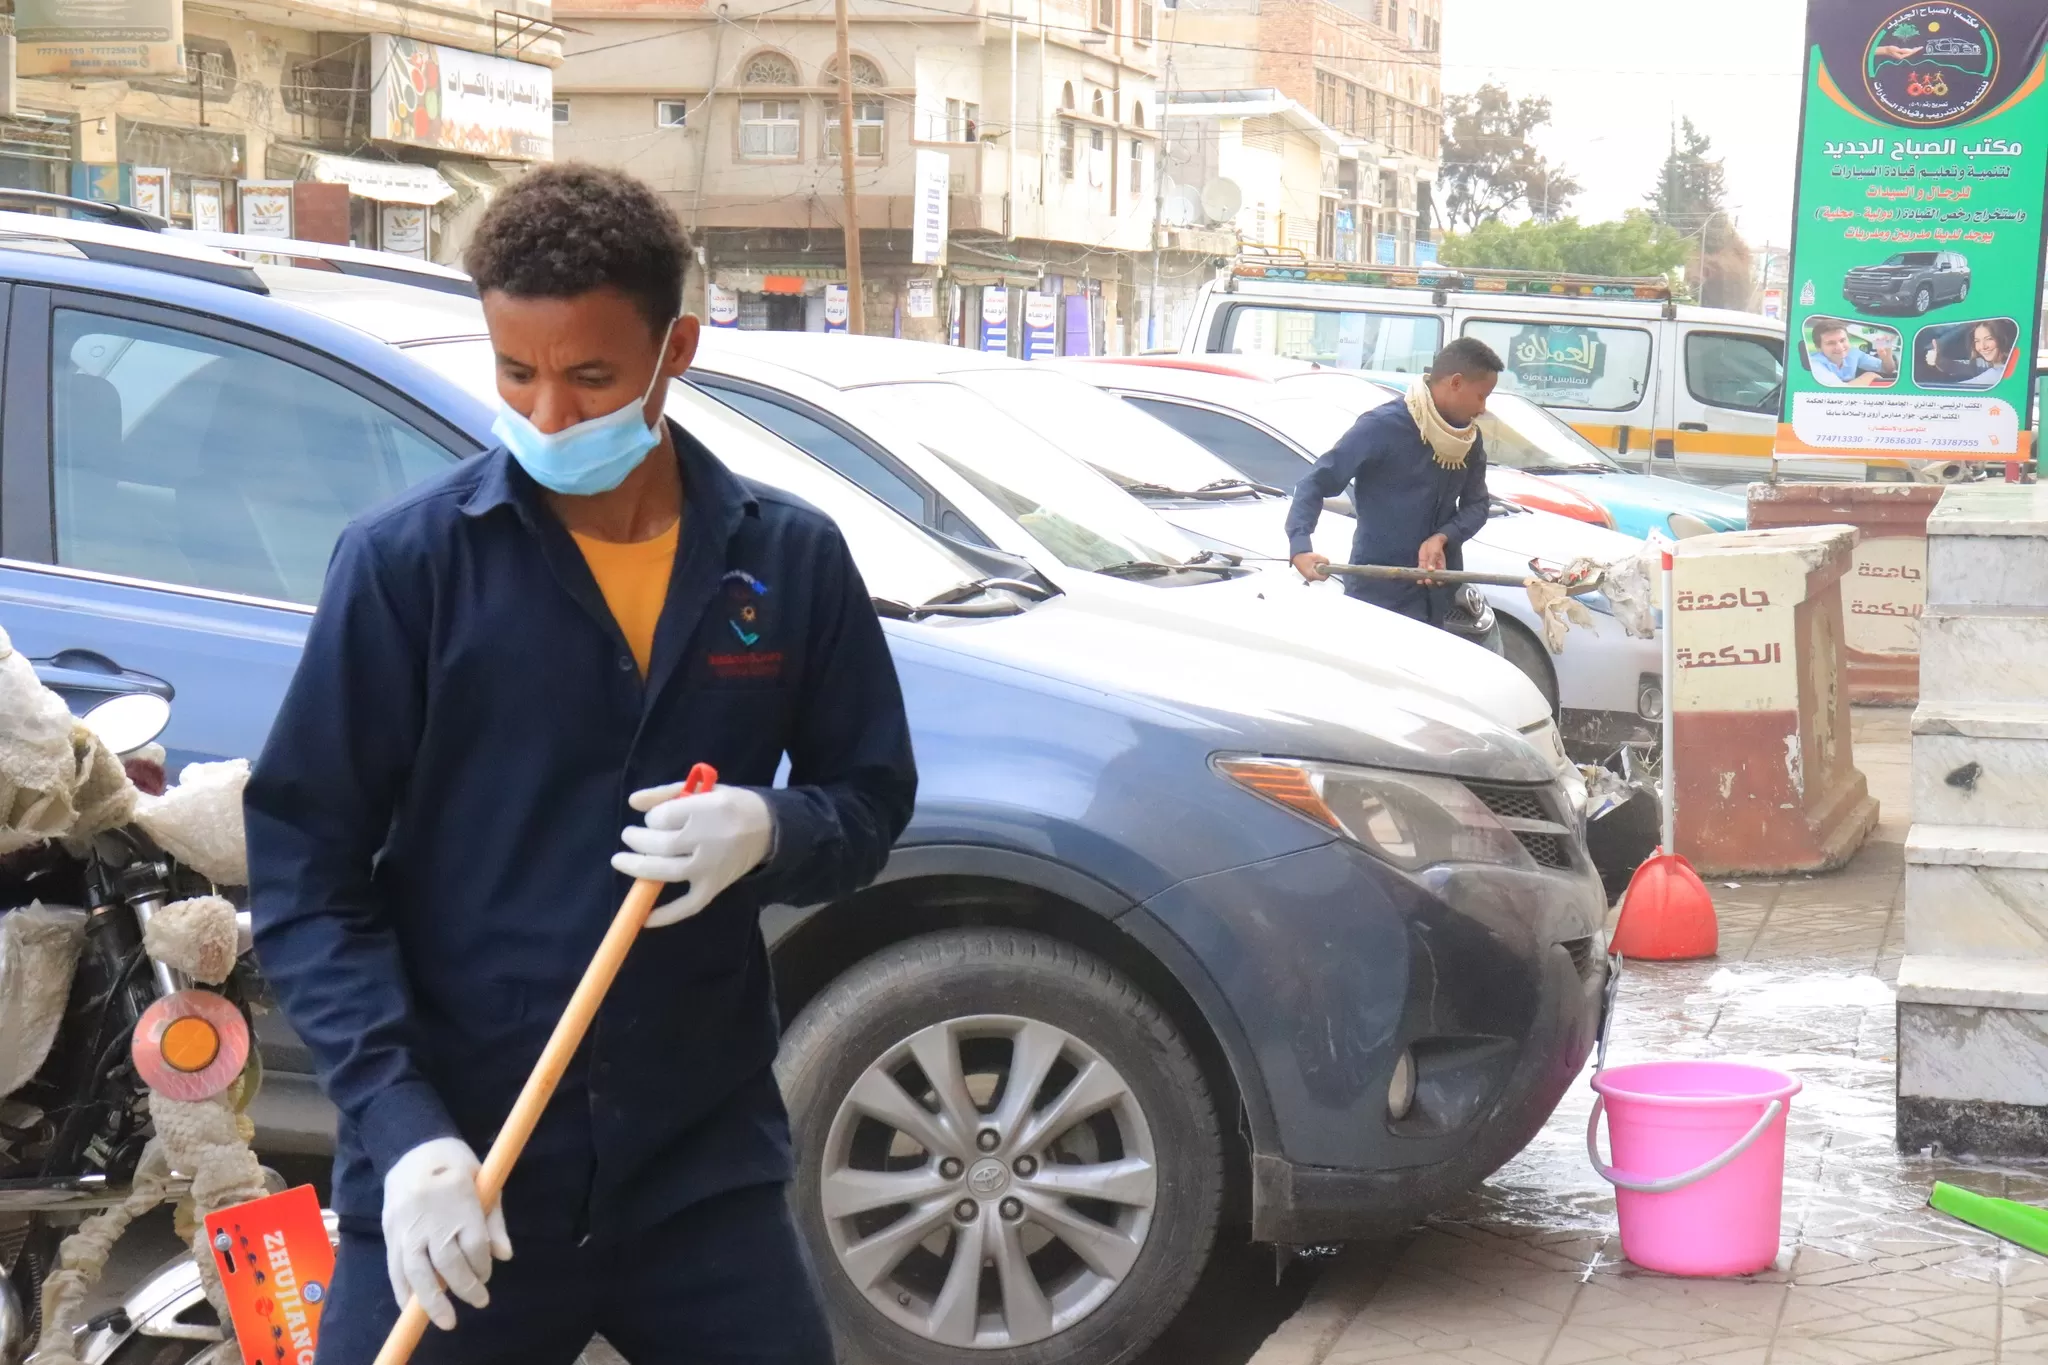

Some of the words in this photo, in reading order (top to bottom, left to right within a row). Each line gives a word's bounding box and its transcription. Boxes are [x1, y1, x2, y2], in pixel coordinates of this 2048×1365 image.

[1887, 8, 1919, 30] الجديد
[1920, 6, 1952, 17] الصباح
[1953, 9, 1979, 28] مكتب
[1873, 81, 1898, 109] السيارات
[1898, 105, 1924, 119] وقيادة
[1926, 105, 1965, 119] والتدريب
[1823, 138, 1884, 159] الجديد
[1890, 138, 1956, 161] الصباح
[1963, 138, 2022, 159] مكتب
[1831, 164, 1882, 179] السيارات
[1884, 164, 1915, 180] قيادة
[1918, 166, 1965, 180] وتعليم
[1967, 165, 2010, 181] لتنمية
[1866, 186, 1914, 199] السيدات
[1926, 186, 1971, 201] للرجال
[1903, 207, 1940, 220] القيادة
[1940, 208, 1971, 222] رخص
[1972, 207, 2026, 223] واستخراج
[1844, 226, 1890, 240] ومدربات
[1891, 228, 1931, 243] مدربين
[1933, 228, 1962, 243] لدينا
[1963, 230, 1994, 244] يوجد
[1516, 334, 1599, 370] العملاق
[1931, 438, 1979, 447] 733787555
[1858, 563, 1921, 582] جامعة
[1677, 587, 1770, 612] جامعة
[1851, 600, 1923, 617] الحكمة
[1676, 642, 1781, 669] الحكمة
[263, 1230, 315, 1365] ZHUJIANG
